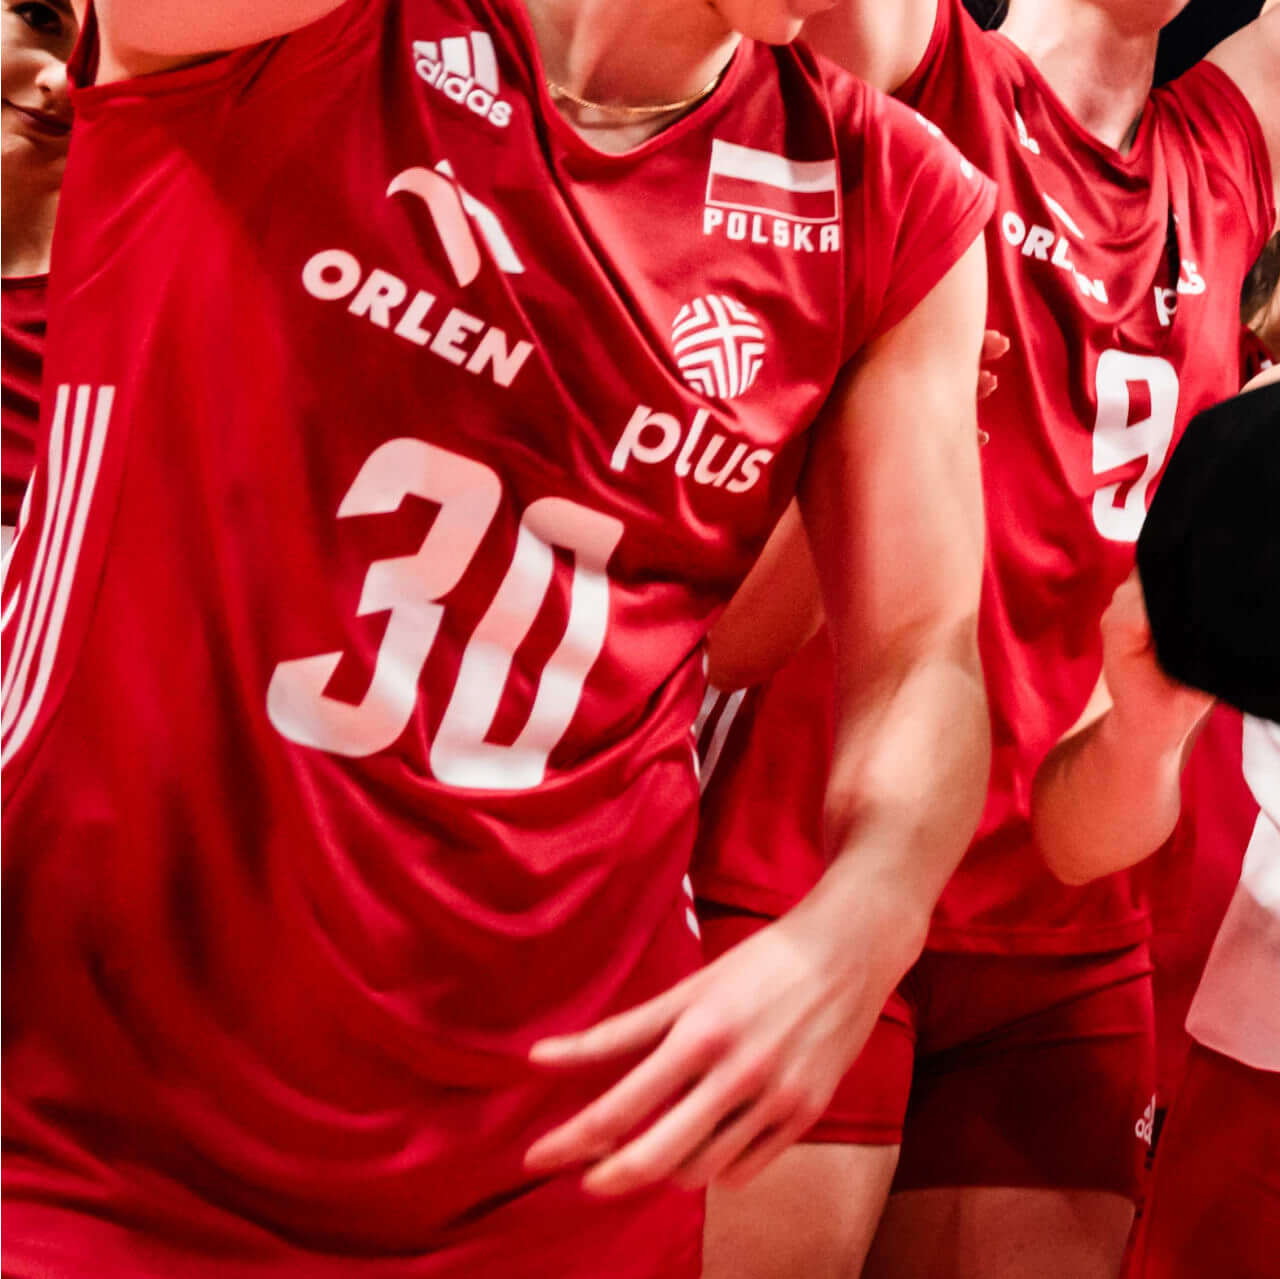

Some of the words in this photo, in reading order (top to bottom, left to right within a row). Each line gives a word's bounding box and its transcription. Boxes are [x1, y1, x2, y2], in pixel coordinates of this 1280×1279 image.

[413, 54, 513, 128] didas
[703, 205, 842, 255] POLSKA
[1002, 210, 1109, 305] ORLN
[301, 248, 535, 389] ORLEN
[611, 403, 775, 495] plus
[1092, 348, 1180, 543] 9
[266, 436, 626, 791] 30
